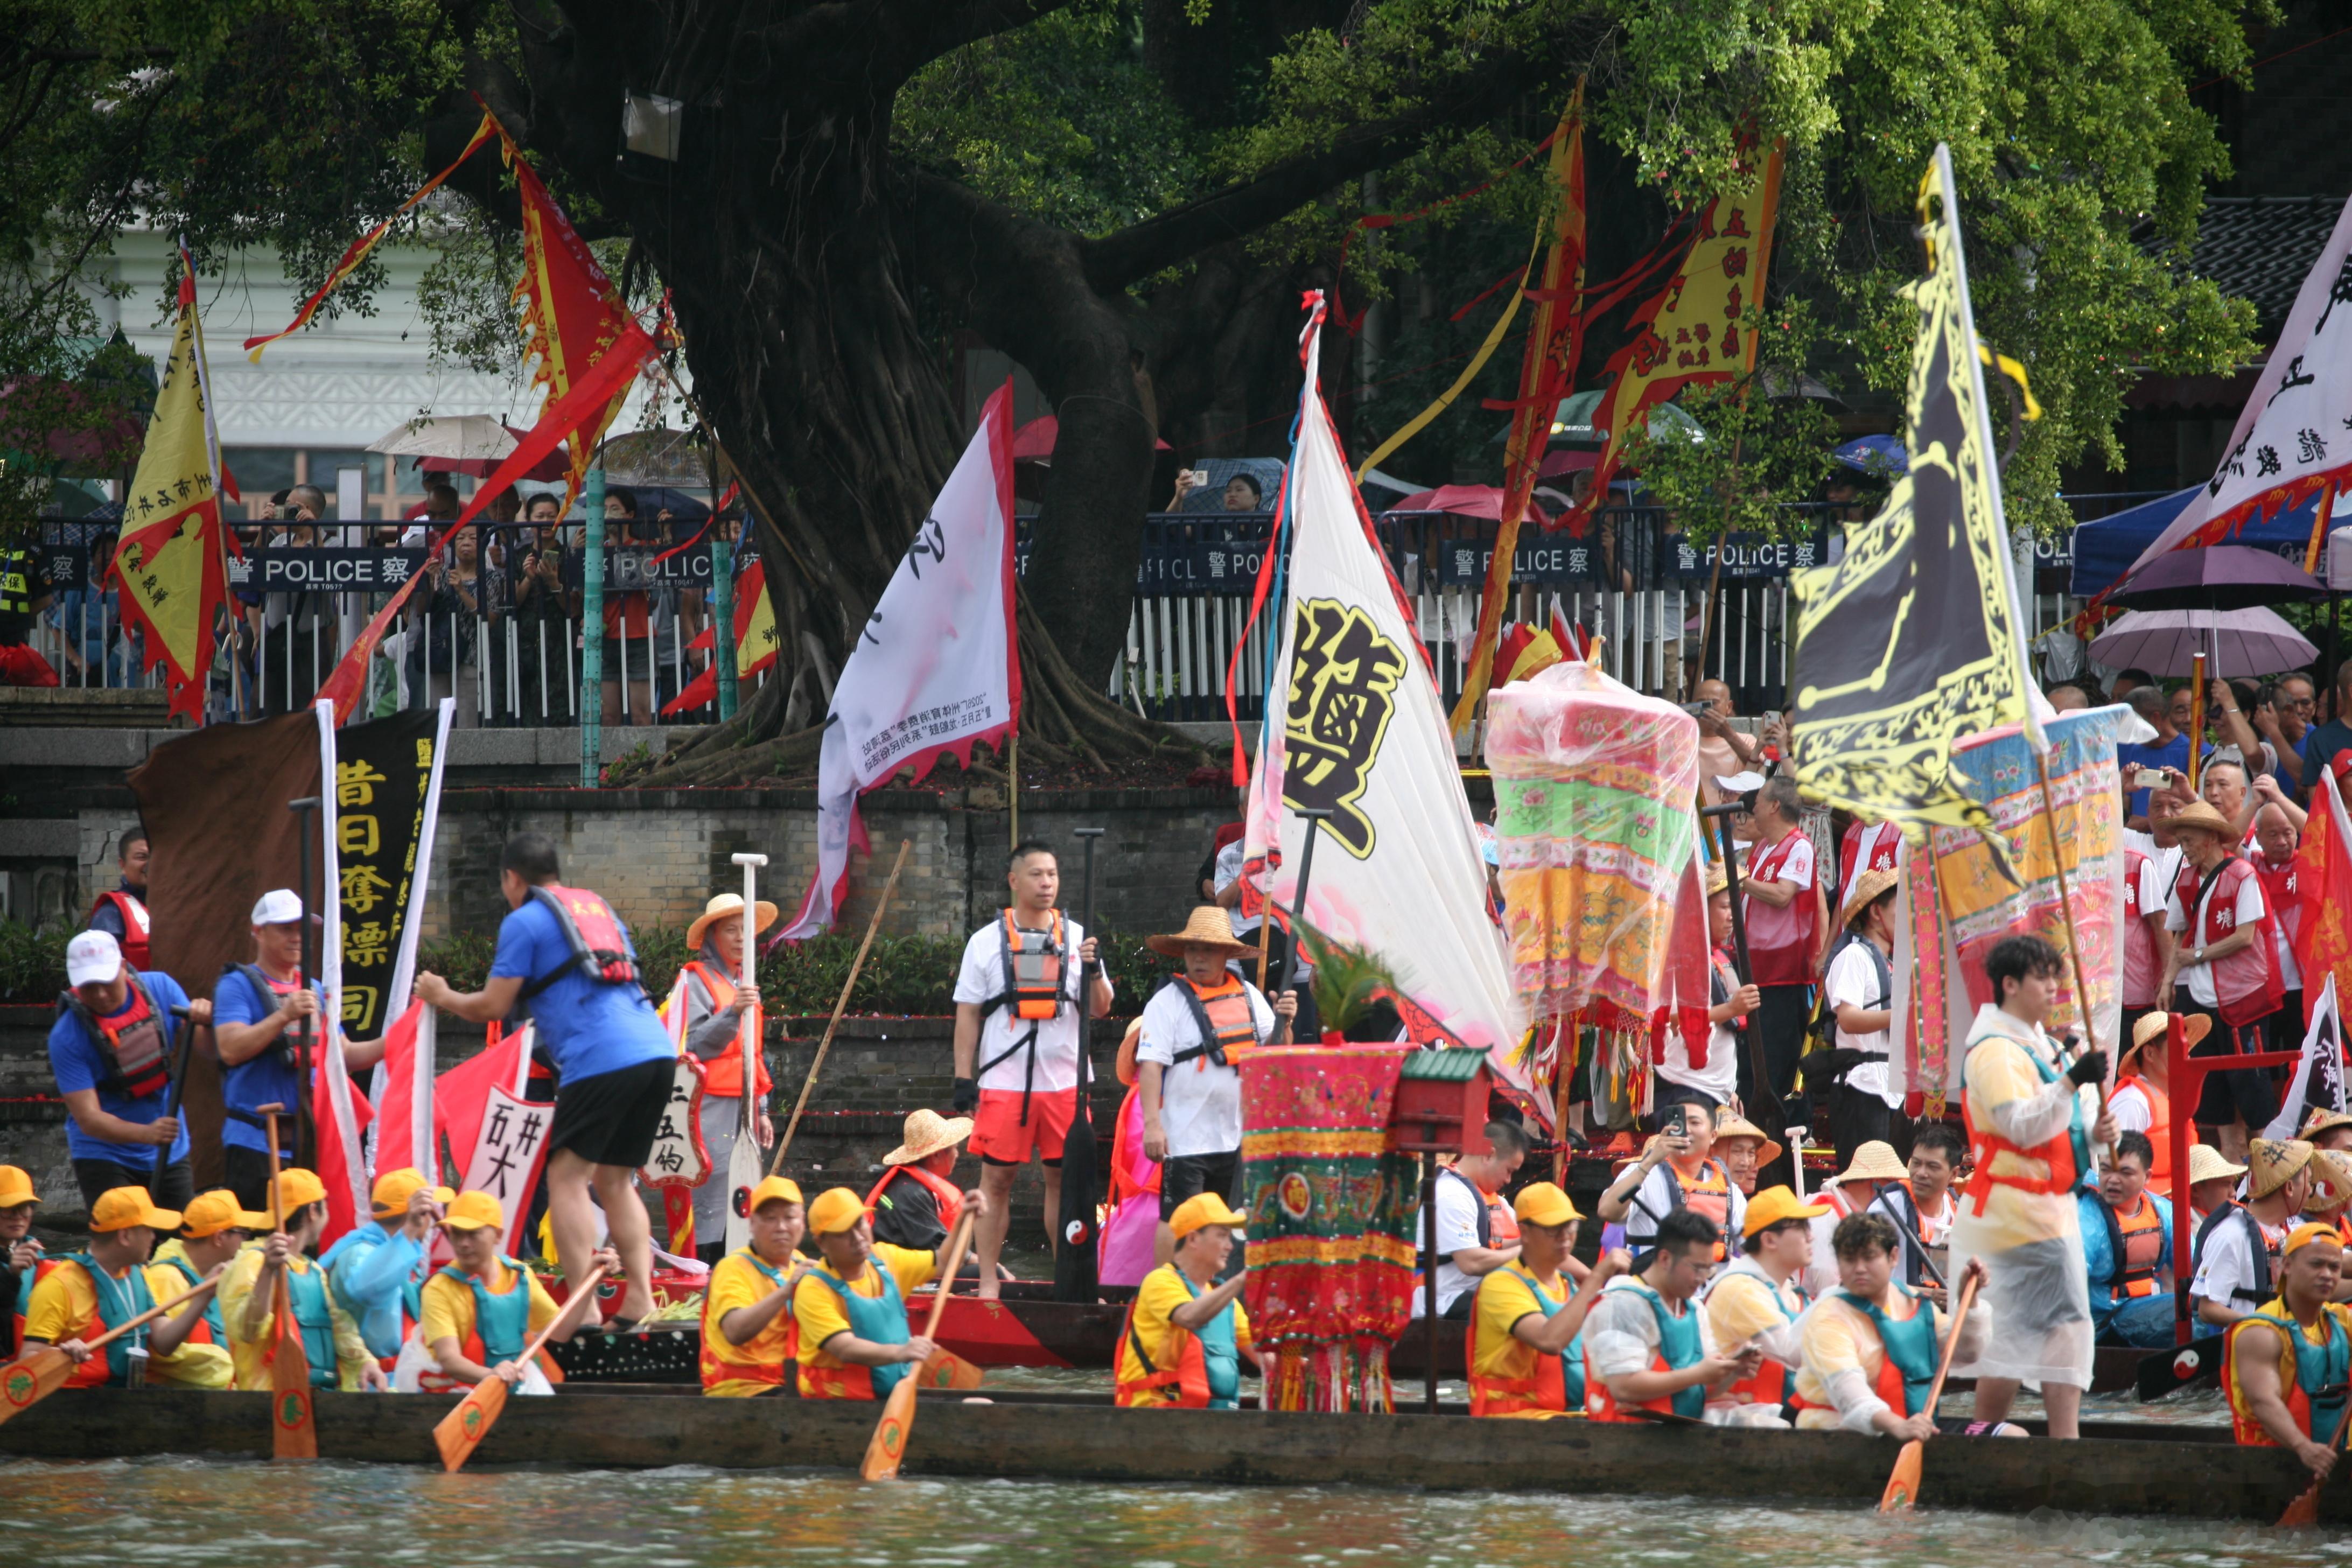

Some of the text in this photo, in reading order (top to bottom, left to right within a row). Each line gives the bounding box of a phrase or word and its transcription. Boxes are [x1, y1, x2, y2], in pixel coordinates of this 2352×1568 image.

[53, 555, 74, 580] 察
[621, 556, 710, 578] POLIC
[1208, 551, 1226, 578] 警
[1455, 547, 1588, 576] 警 PLICE 察
[1678, 541, 1815, 569] 警 POLICE 察
[227, 556, 409, 583] 警 POLICE 察
[1875, 851, 1892, 872] 塘
[2216, 907, 2234, 930] 塘
